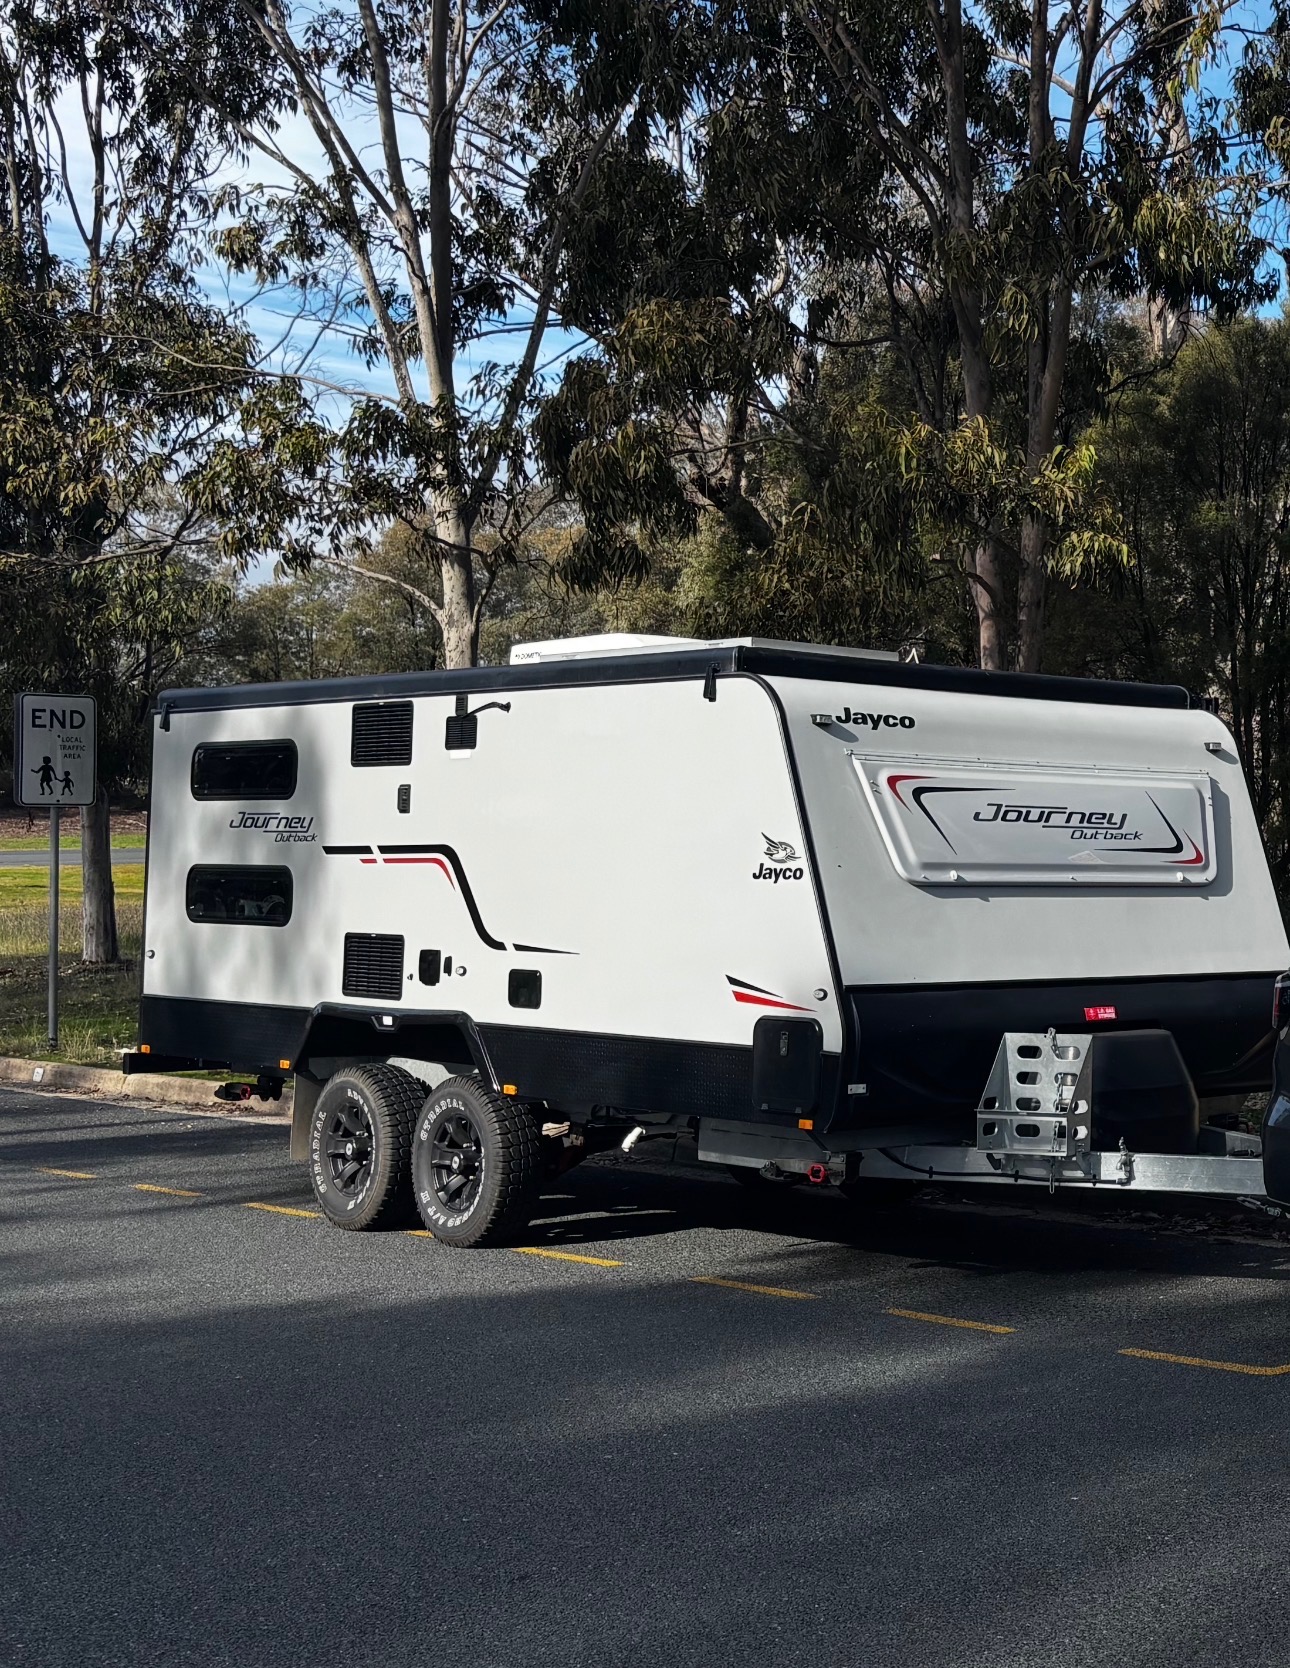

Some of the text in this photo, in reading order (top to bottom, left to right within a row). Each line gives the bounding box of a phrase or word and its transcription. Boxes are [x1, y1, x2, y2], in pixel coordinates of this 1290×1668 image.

[31, 708, 86, 730] END
[835, 707, 916, 731] Jayco
[59, 744, 87, 752] TRAFFIC
[61, 736, 83, 744] LOCAL
[229, 811, 314, 833] Journey
[973, 802, 1128, 830] Journey
[274, 832, 319, 843] Outback
[1070, 829, 1144, 841] Outback
[752, 862, 804, 884] Jayco
